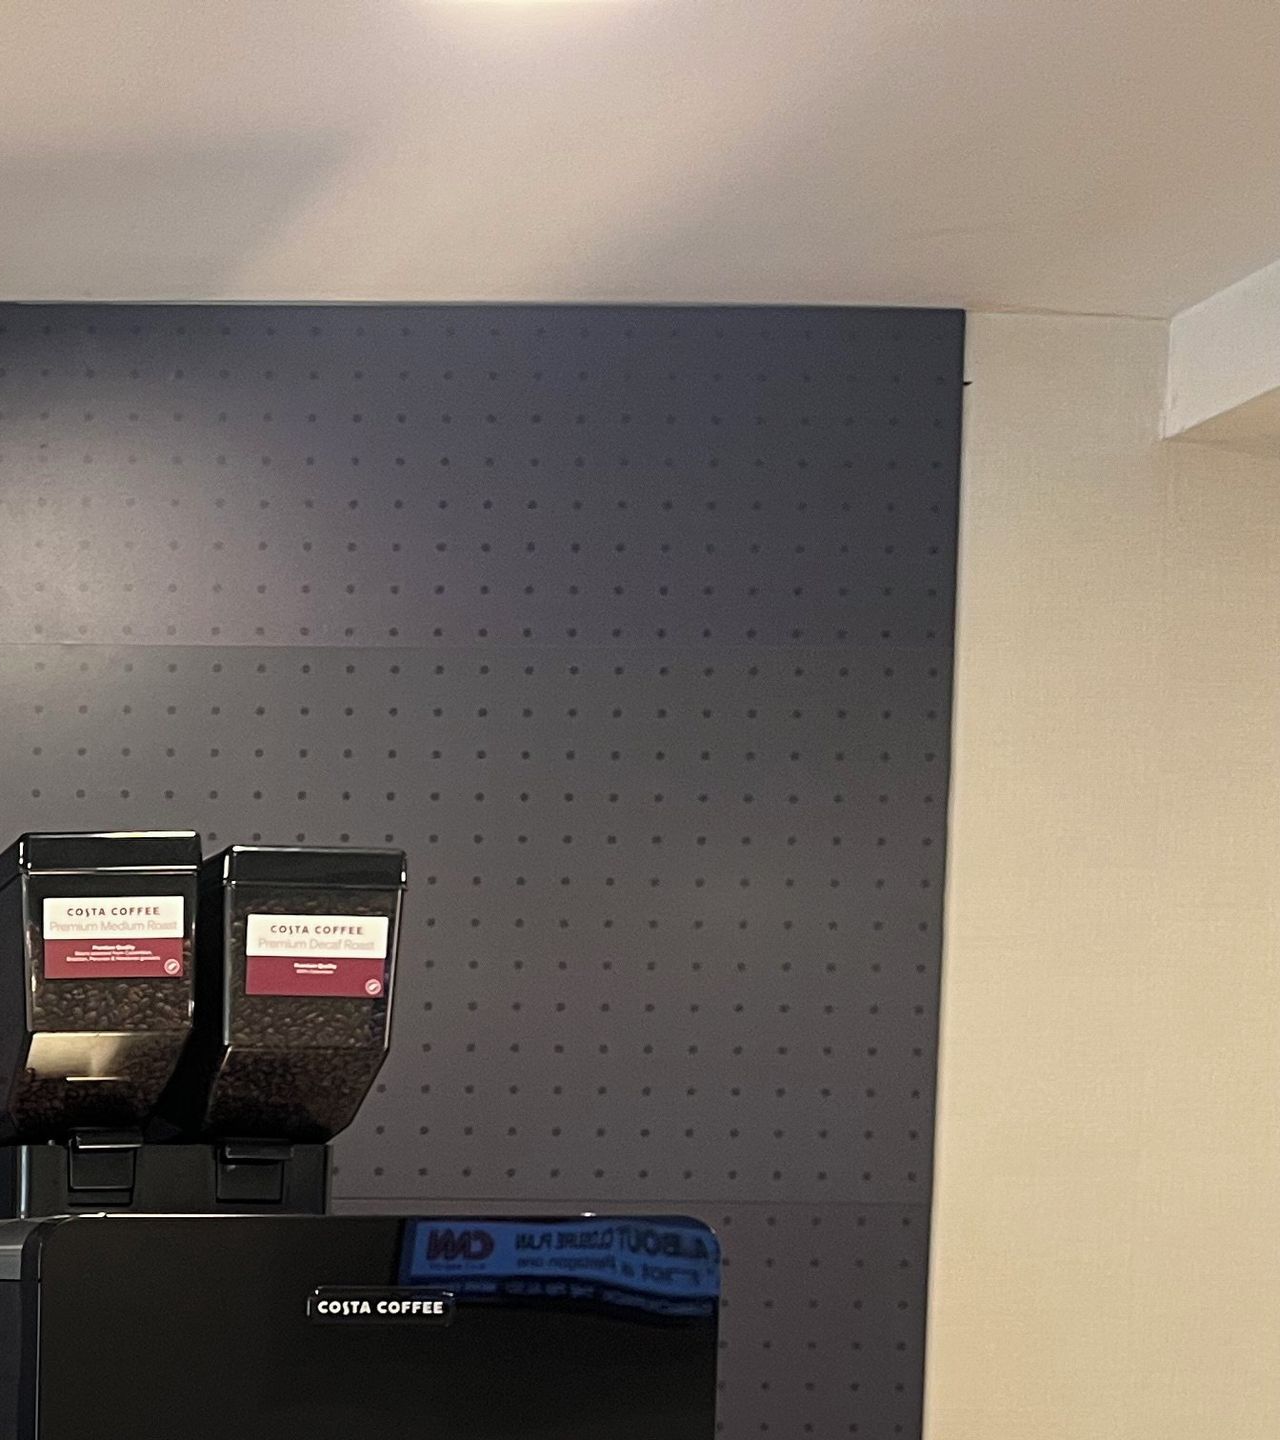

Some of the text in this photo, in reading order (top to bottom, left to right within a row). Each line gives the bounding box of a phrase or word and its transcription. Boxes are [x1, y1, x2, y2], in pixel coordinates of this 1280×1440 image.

[66, 906, 161, 917] COSTA COFFEE
[49, 920, 177, 931] Premium Medium Roast
[270, 925, 364, 935] COSTA COFFEE
[258, 938, 375, 950] Premium Decaf Roast
[317, 1300, 444, 1316] COSTA COFFEE
